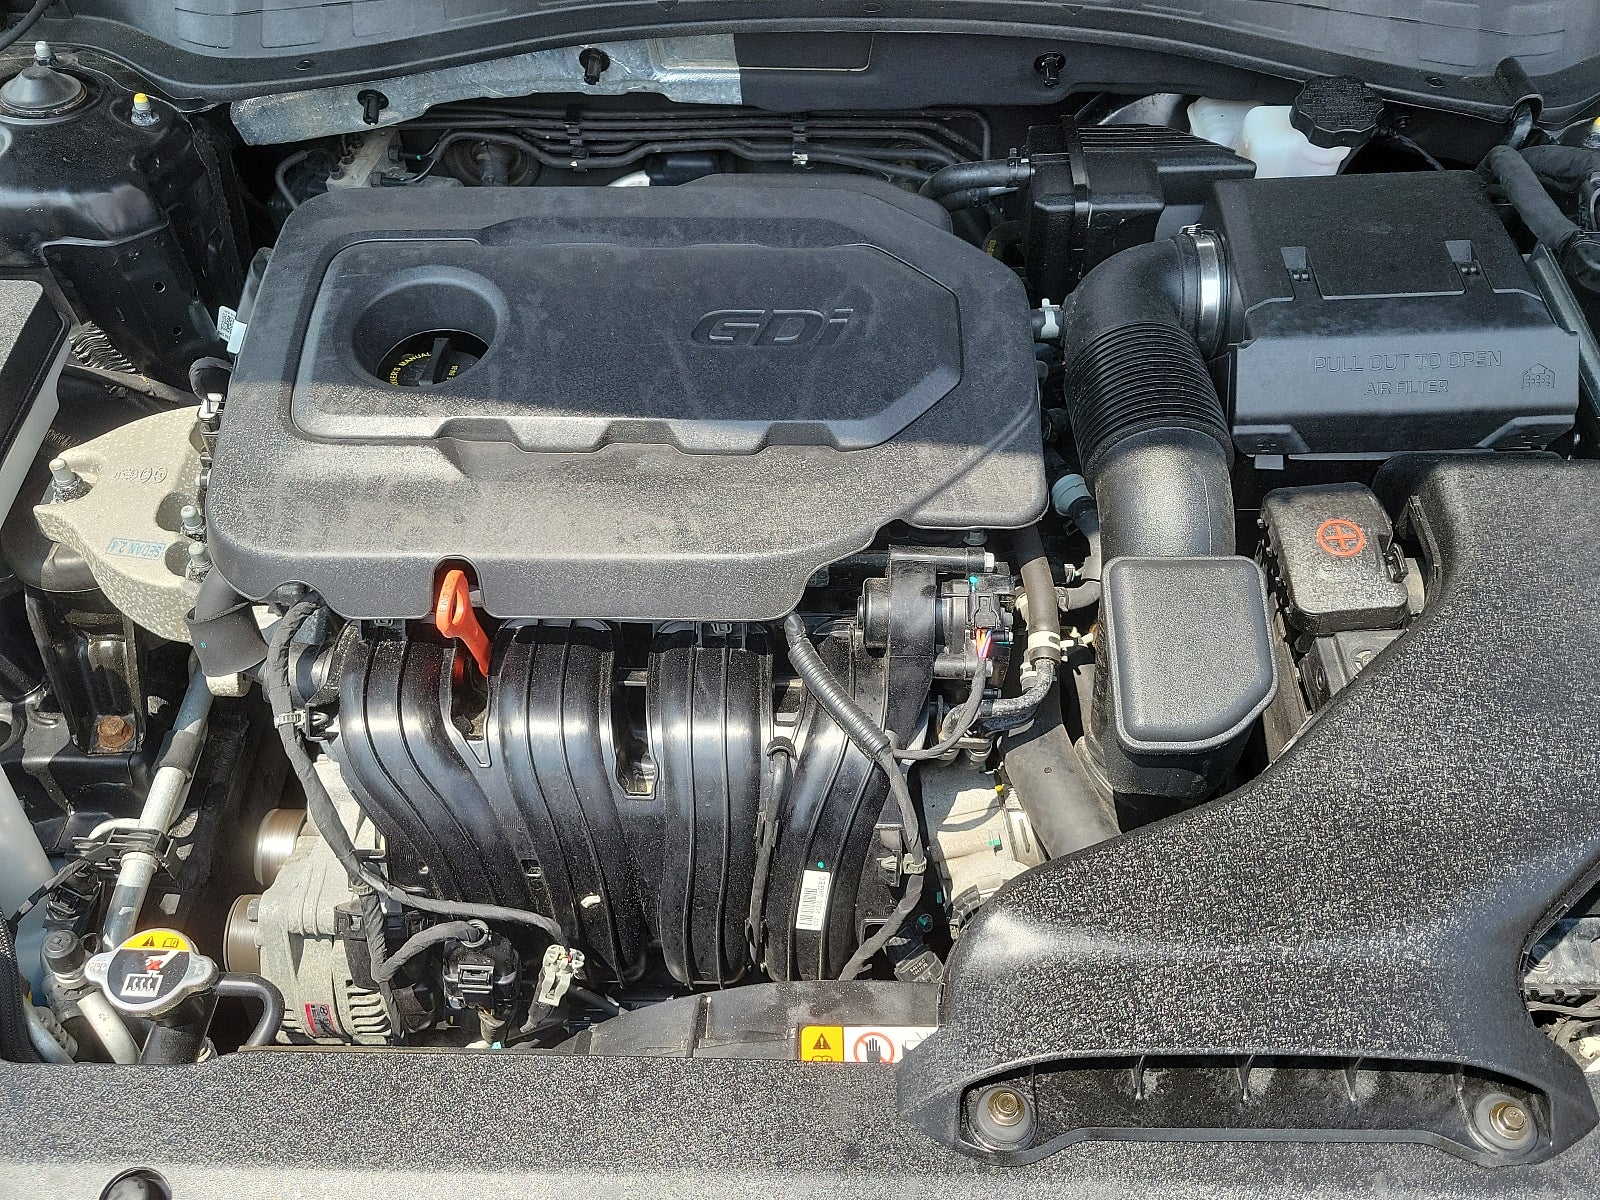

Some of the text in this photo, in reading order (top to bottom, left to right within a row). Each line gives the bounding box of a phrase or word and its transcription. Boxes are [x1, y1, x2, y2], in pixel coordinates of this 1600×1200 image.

[690, 308, 853, 347] GDi
[398, 351, 432, 367] MANUAL
[1313, 350, 1502, 373] PULL OUT TO OPEN
[1364, 379, 1449, 395] AIR FILTER
[129, 543, 163, 557] SEDAN
